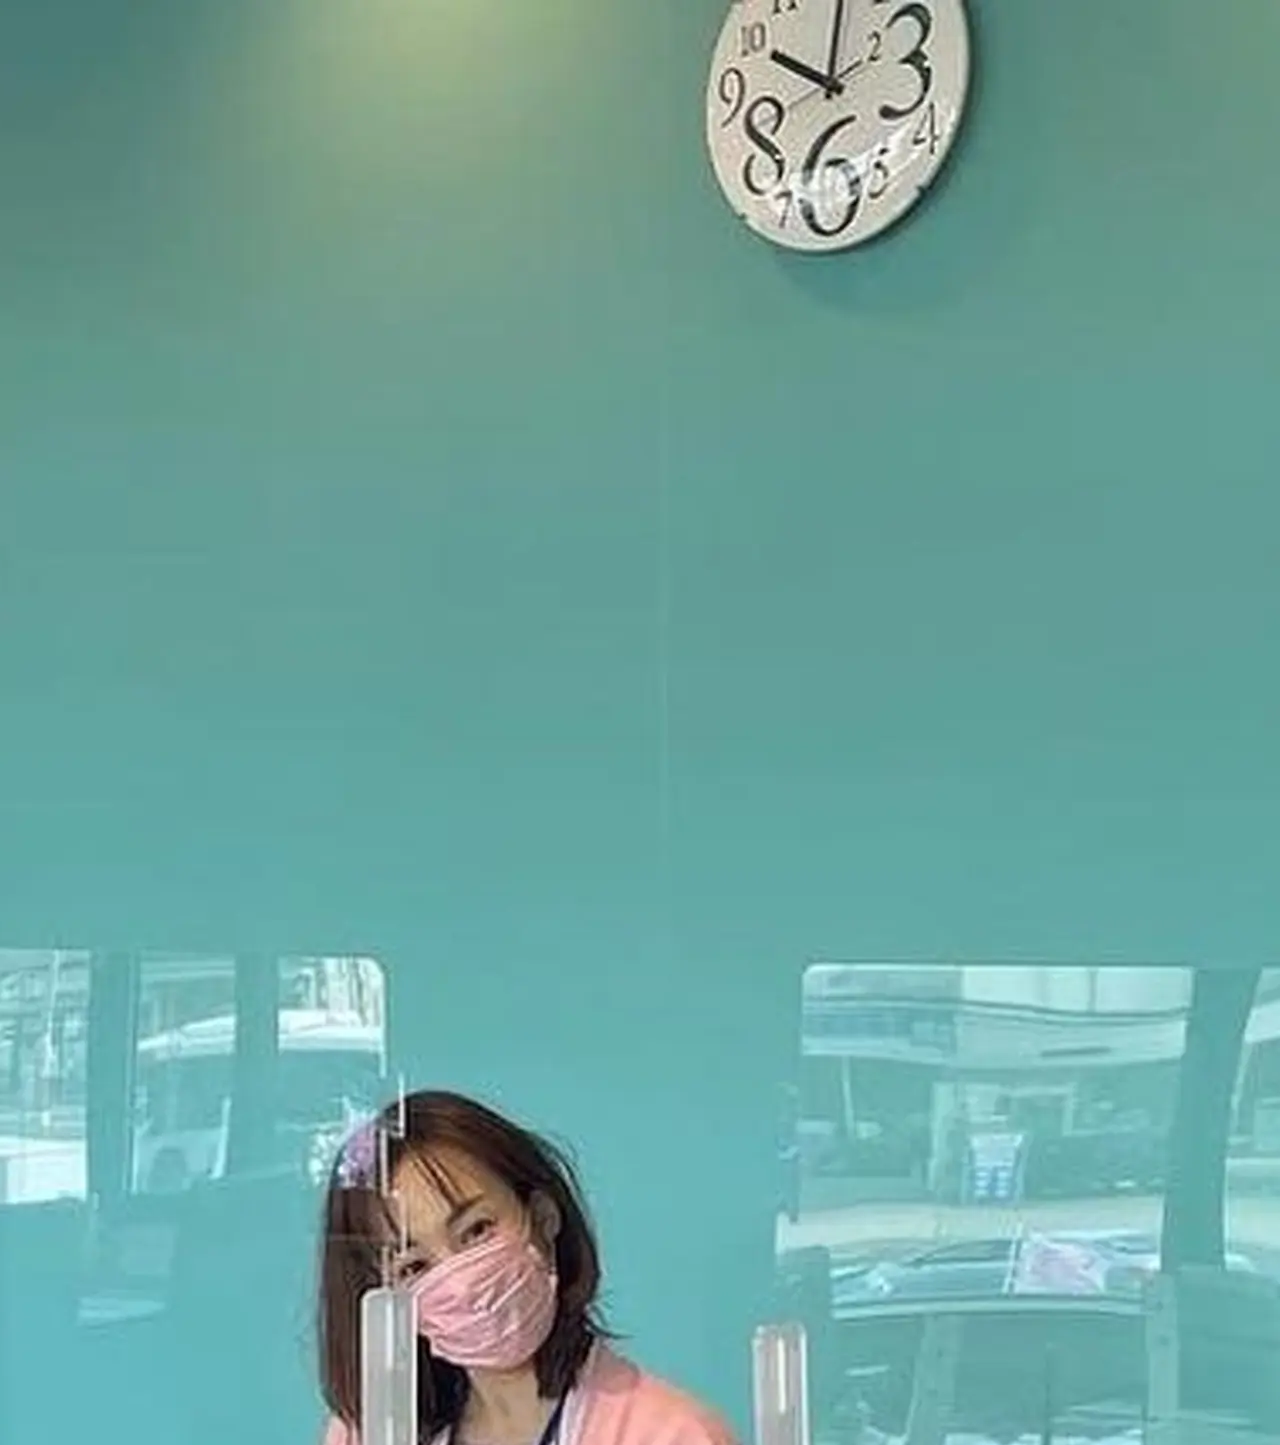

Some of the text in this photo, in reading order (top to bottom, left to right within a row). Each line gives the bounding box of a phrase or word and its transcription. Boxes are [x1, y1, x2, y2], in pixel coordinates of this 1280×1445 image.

[741, 23, 766, 57] 10
[867, 30, 883, 62] 2
[879, 2, 932, 120] 3
[719, 67, 745, 128] 9
[743, 96, 785, 196] 8
[912, 101, 940, 155] 4
[798, 115, 861, 237] 6
[868, 147, 890, 199] 5
[775, 190, 793, 229] 7
